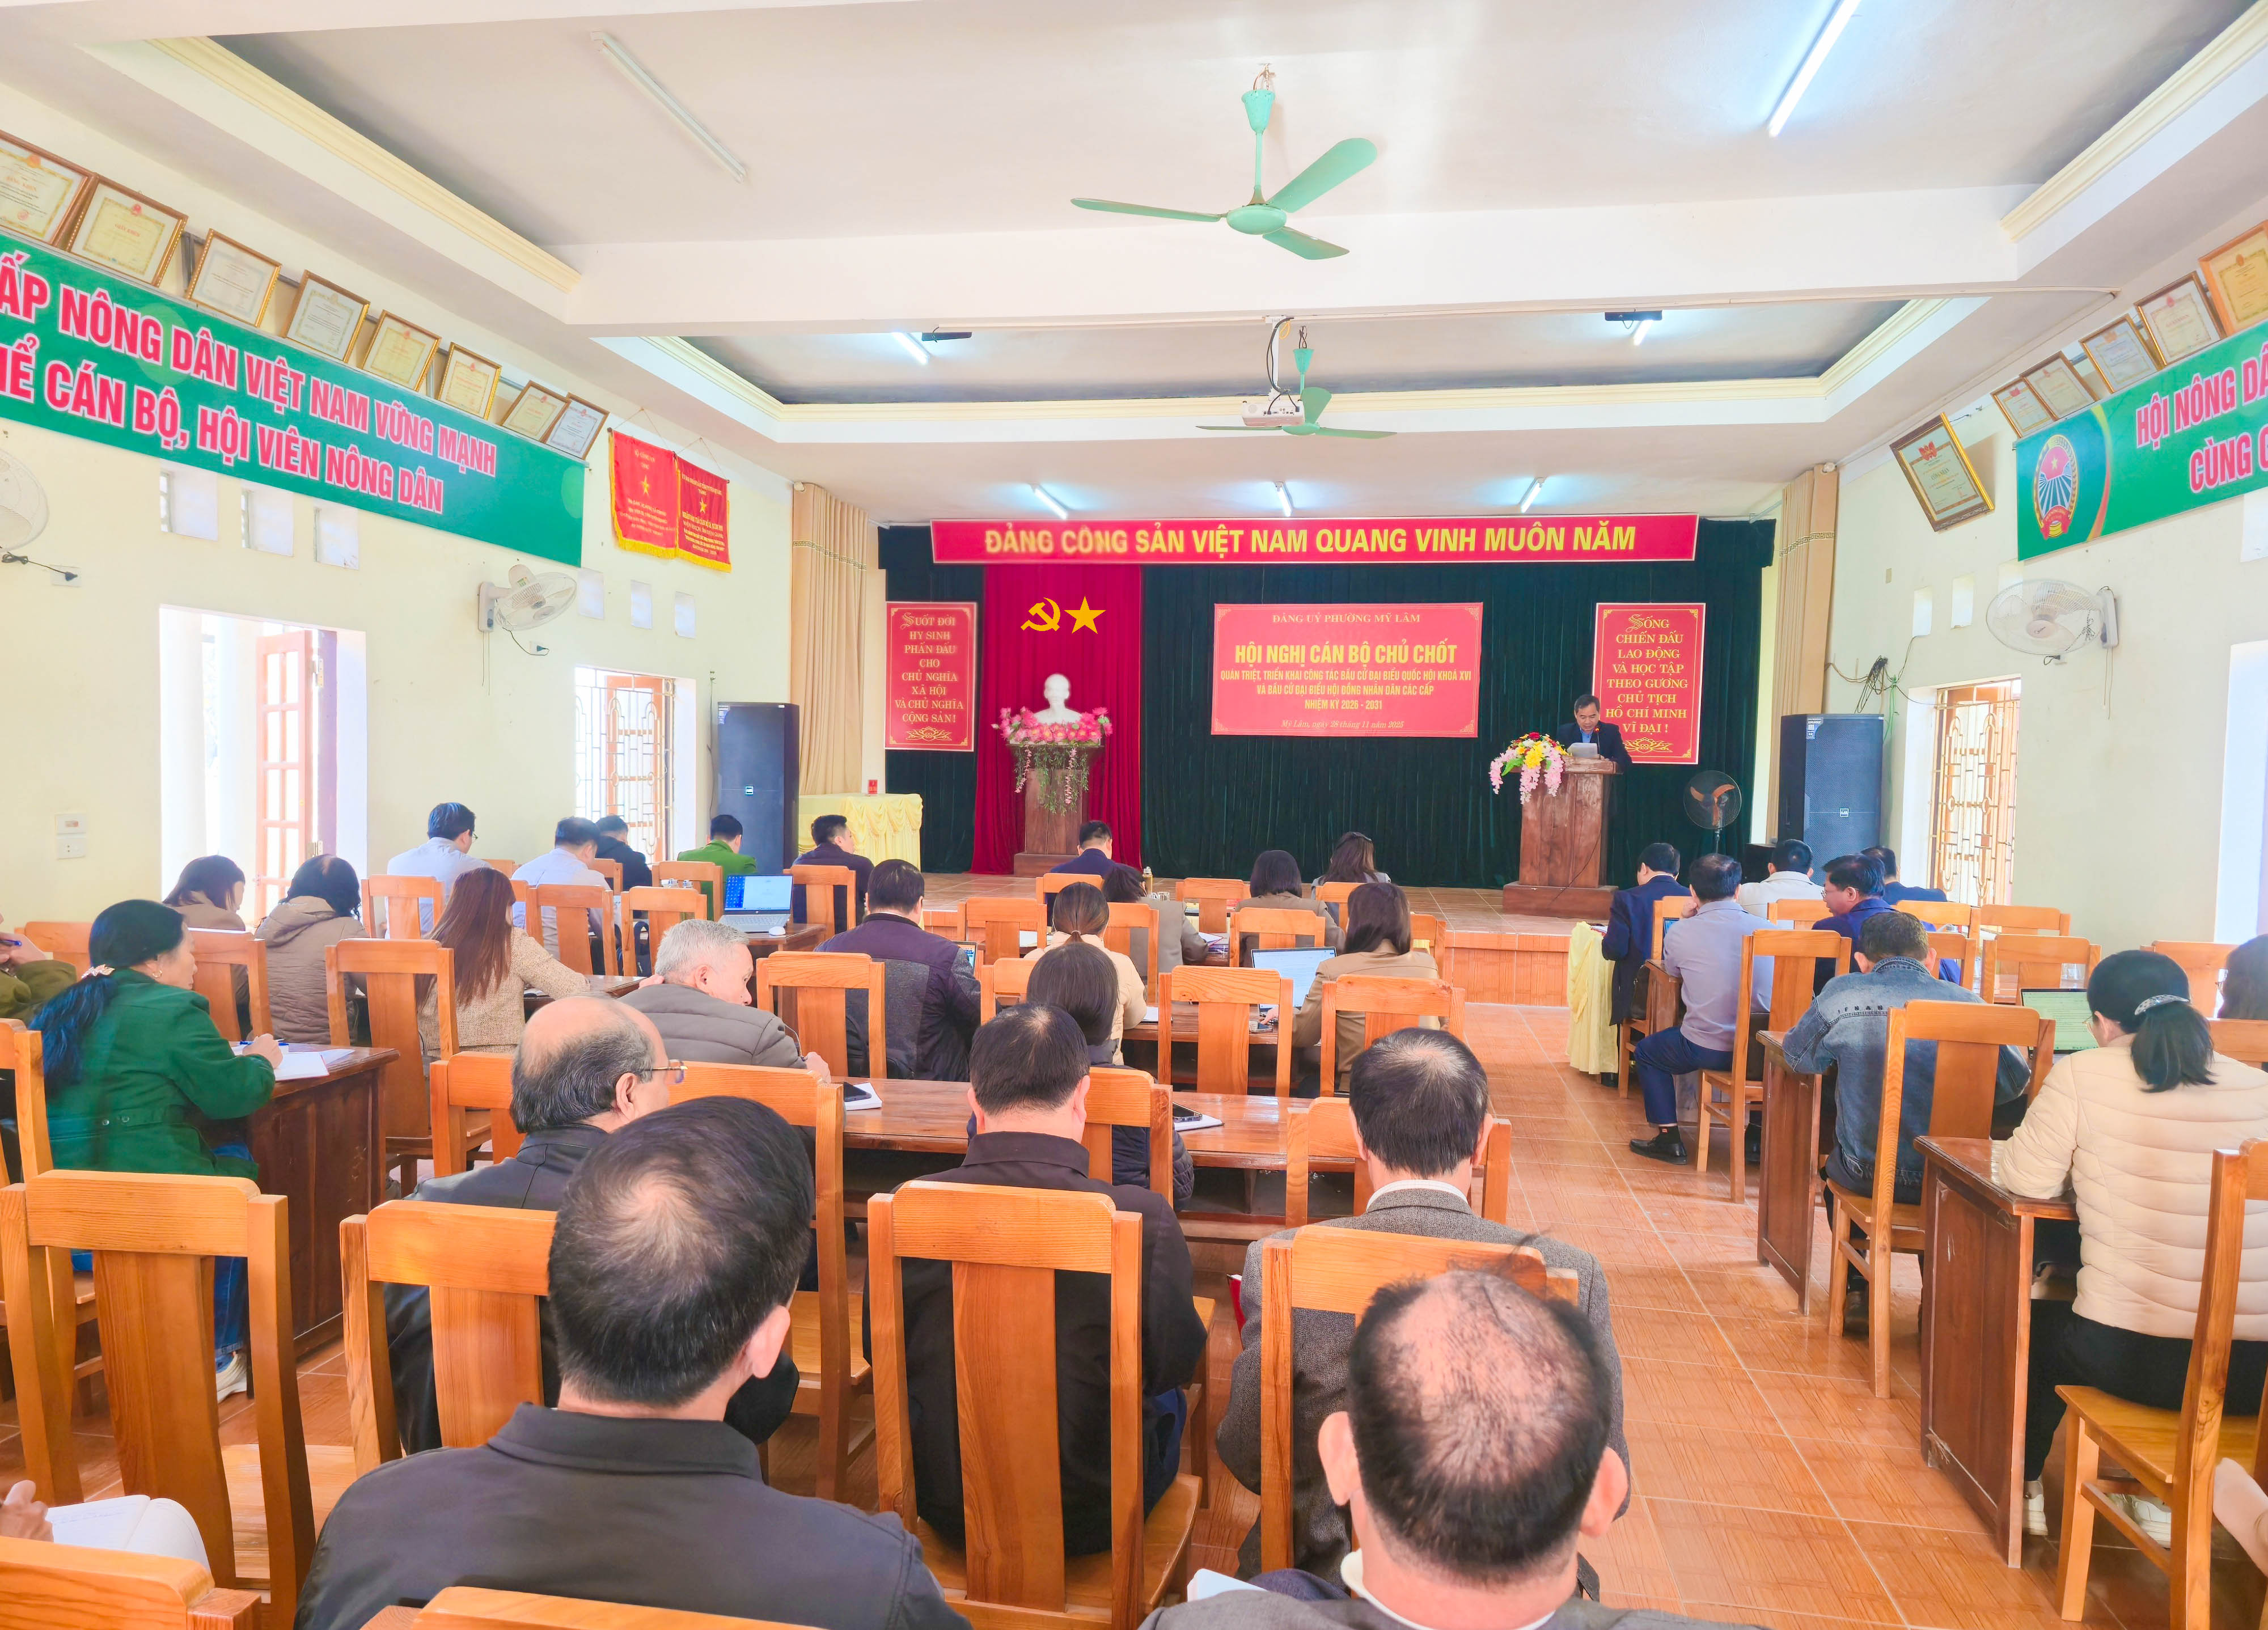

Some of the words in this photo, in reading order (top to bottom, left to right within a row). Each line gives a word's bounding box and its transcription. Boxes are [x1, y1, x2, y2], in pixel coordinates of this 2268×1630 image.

[59, 283, 163, 366] NÔNG
[170, 327, 239, 391] DÂN
[244, 355, 306, 415] VIỆT
[310, 376, 370, 434] NAM
[374, 400, 434, 455] VỮNG
[438, 424, 497, 477] MẠNH
[2136, 392, 2169, 451] HỘI
[2174, 367, 2237, 433] NÔNG
[45, 359, 126, 427] CÁN
[132, 386, 189, 450] BỘ,
[197, 405, 250, 467] HỘI
[256, 422, 320, 481] VIÊN
[325, 444, 393, 501] NÔNG
[398, 466, 443, 515] DÂN
[2190, 432, 2253, 493] CÙNG
[985, 522, 1053, 554] ĐẢNG
[1136, 522, 1184, 553] SẢN
[1192, 524, 1243, 558] VIỆT
[1251, 529, 1308, 552] NAM
[1316, 528, 1407, 552] QUANG
[1415, 528, 1475, 552] VINH
[1484, 522, 1564, 551] MUÔN
[1573, 521, 1636, 550] NĂM
[900, 612, 934, 630] SUỐT
[938, 615, 955, 626] ĐỜI
[1273, 612, 1304, 623] ĐẢNG
[1325, 612, 1371, 623] PHƯỜNG
[1374, 611, 1393, 623] MỸ
[1395, 612, 1420, 623] LÂM
[1626, 613, 1669, 632] SỐNG
[909, 631, 923, 640] HY
[926, 631, 950, 640] SINH
[1616, 630, 1655, 643] CHIẾN
[1660, 630, 1683, 643] ĐẤU
[904, 642, 933, 653] PHẤN
[936, 642, 955, 653] ĐẤU
[1235, 641, 1262, 667] HỘI
[1267, 645, 1305, 667] NGHỊ
[1310, 639, 1345, 663] CÁN
[1348, 641, 1370, 667] BỘ
[1375, 638, 1408, 663] CHỦ
[1414, 638, 1457, 663] CHỐT
[1618, 649, 1642, 658] LAO
[1646, 647, 1679, 661] ĐỘNG
[920, 659, 940, 667] CHO
[1613, 661, 1626, 673] VÀ
[1632, 664, 1656, 675] HỌC
[1660, 662, 1684, 676] TẬP
[902, 670, 922, 681] CHỦ
[926, 671, 958, 681] NGHĨA
[1285, 670, 1302, 680] KHAI
[1304, 668, 1323, 680] CÔNG
[1459, 671, 1471, 680] XVI
[1386, 683, 1400, 695] DÂN
[1607, 679, 1641, 688] THEO
[1645, 678, 1688, 688] GƯƠNG
[912, 684, 925, 695] XÃ
[930, 684, 946, 697] HỘI
[1618, 690, 1643, 703] CHỦ
[1648, 694, 1676, 705] TỊCH
[895, 698, 906, 708] VÀ
[908, 697, 928, 708] CHỦ
[932, 698, 963, 709] NGHĨA
[1305, 698, 1328, 710] NHIỆM
[1342, 700, 1359, 709] 2026
[1365, 700, 1382, 709] 2031
[903, 710, 928, 724] CỘNG
[1606, 704, 1623, 718] HỒ
[1627, 706, 1649, 718] CHÍ
[1653, 709, 1687, 718] MINH
[1623, 721, 1637, 733] VĨ
[1640, 723, 1661, 735] ĐẠI
